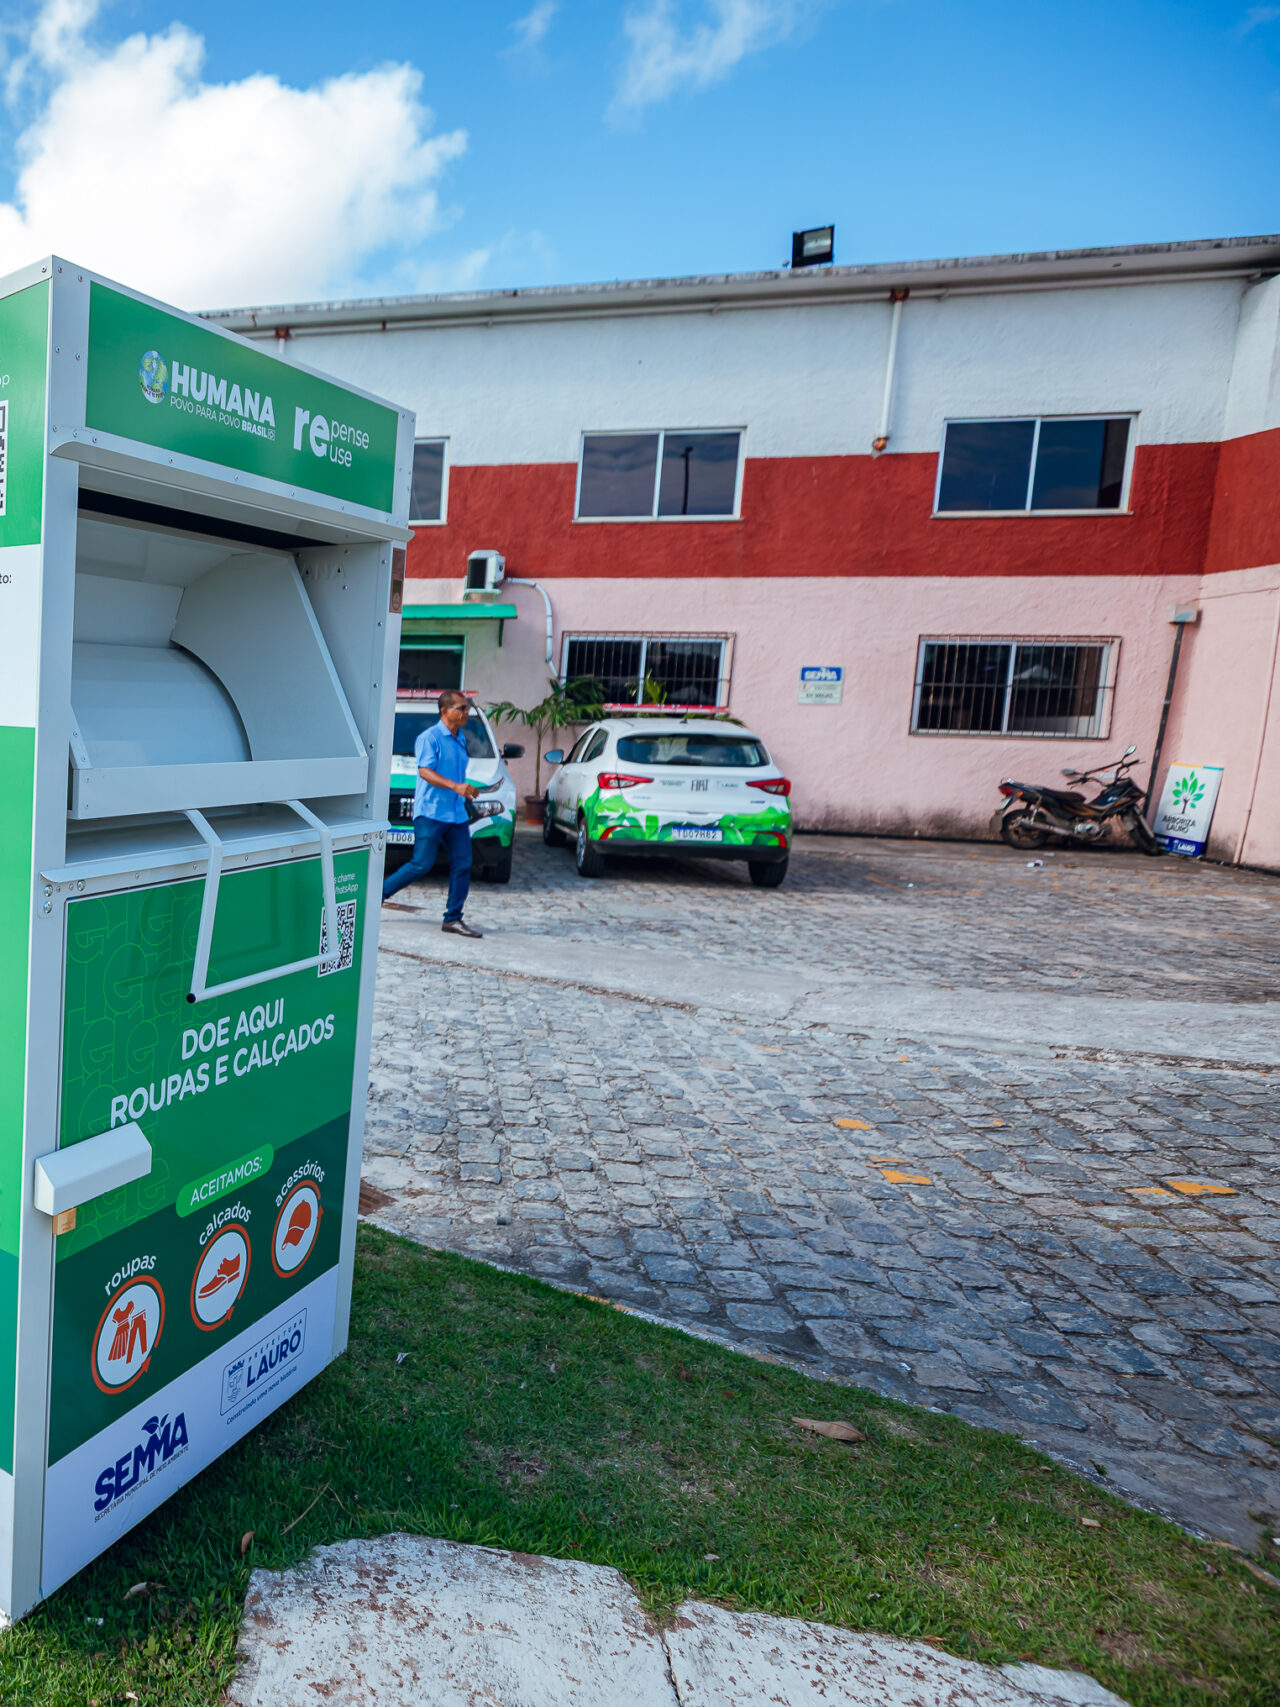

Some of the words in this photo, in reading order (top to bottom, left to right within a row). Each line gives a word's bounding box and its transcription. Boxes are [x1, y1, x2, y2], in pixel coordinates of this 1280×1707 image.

[170, 396, 194, 413] POVO
[196, 404, 217, 422] PARA
[219, 412, 240, 429] POVO
[242, 420, 268, 438] BRASIL
[171, 360, 275, 428] HUMANA
[330, 418, 370, 449] pense
[330, 446, 352, 467] use
[690, 778, 709, 792] FIAT
[334, 883, 358, 895] hatsApp
[182, 1016, 230, 1060] DOE
[234, 998, 284, 1040] AQUI
[110, 1063, 210, 1129] ROUPAS
[215, 1054, 228, 1086] E
[232, 1014, 335, 1078] CALÇADOS
[190, 1156, 263, 1206] ACEITAMOS:
[274, 1159, 326, 1207] acessórios
[198, 1200, 252, 1246] calçados
[104, 1253, 157, 1296] roupas
[246, 1329, 302, 1388] LAURO
[94, 1412, 189, 1512] SEMMA
